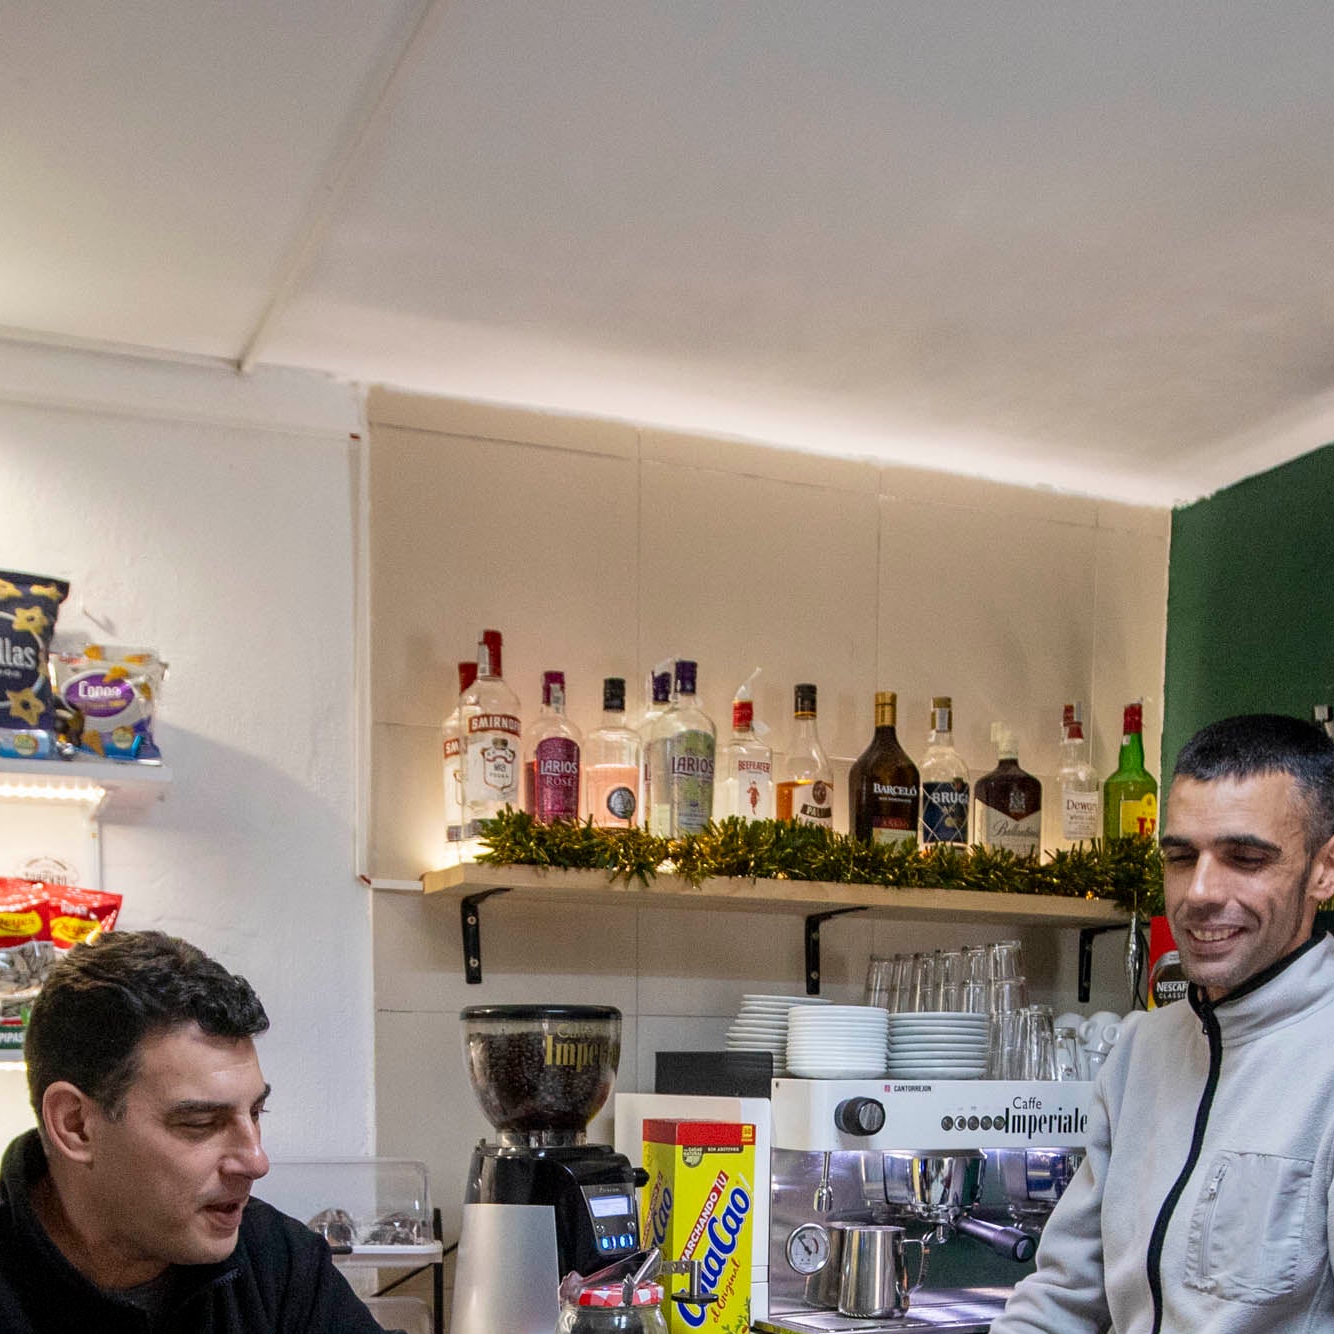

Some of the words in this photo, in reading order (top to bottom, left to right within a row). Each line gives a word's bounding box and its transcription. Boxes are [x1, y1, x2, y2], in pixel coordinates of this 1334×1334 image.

[540, 760, 578, 776] LARIOS
[671, 756, 714, 776] LARIOS
[738, 760, 771, 774] BEEFEATER
[873, 782, 917, 797] BARCELÓ
[1157, 982, 1188, 993] NESCAF
[1013, 1097, 1042, 1110] Caffe
[1005, 1107, 1087, 1139] Imperiale
